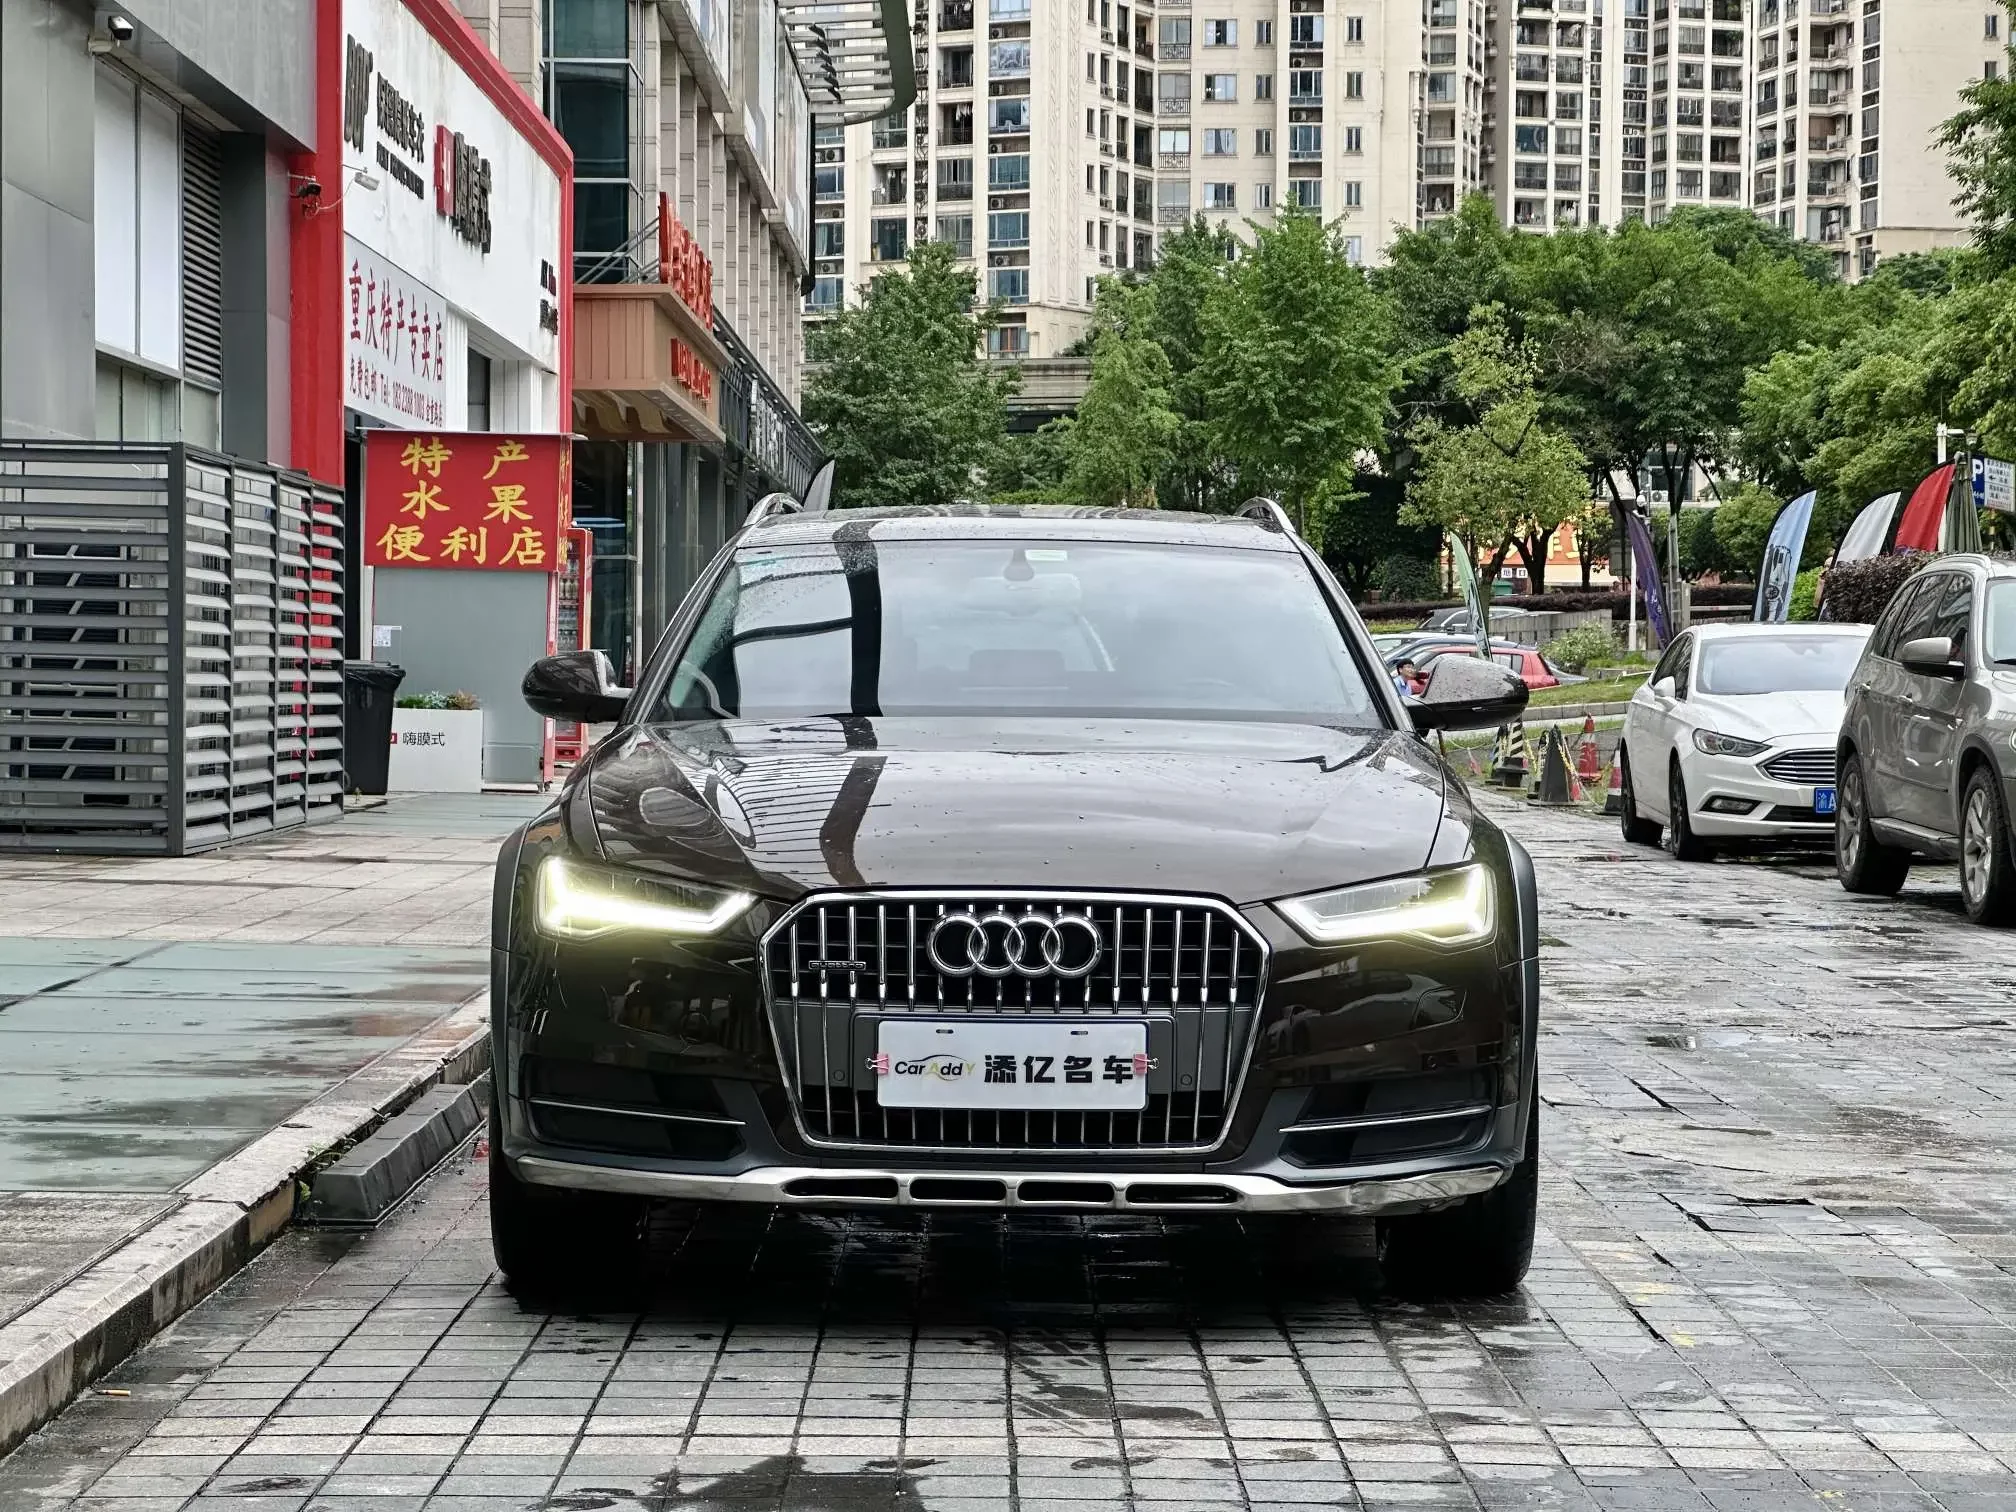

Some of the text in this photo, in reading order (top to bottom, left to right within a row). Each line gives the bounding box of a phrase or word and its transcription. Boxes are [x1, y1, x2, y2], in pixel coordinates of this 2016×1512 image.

[349, 257, 443, 381] 重庆特产专卖店
[400, 436, 530, 480] 特产
[1972, 458, 1984, 481] P
[400, 480, 533, 523] 水果
[376, 523, 546, 565] 便利店
[402, 731, 445, 746] 嗨膜式
[984, 1055, 1134, 1084] 添亿名车
